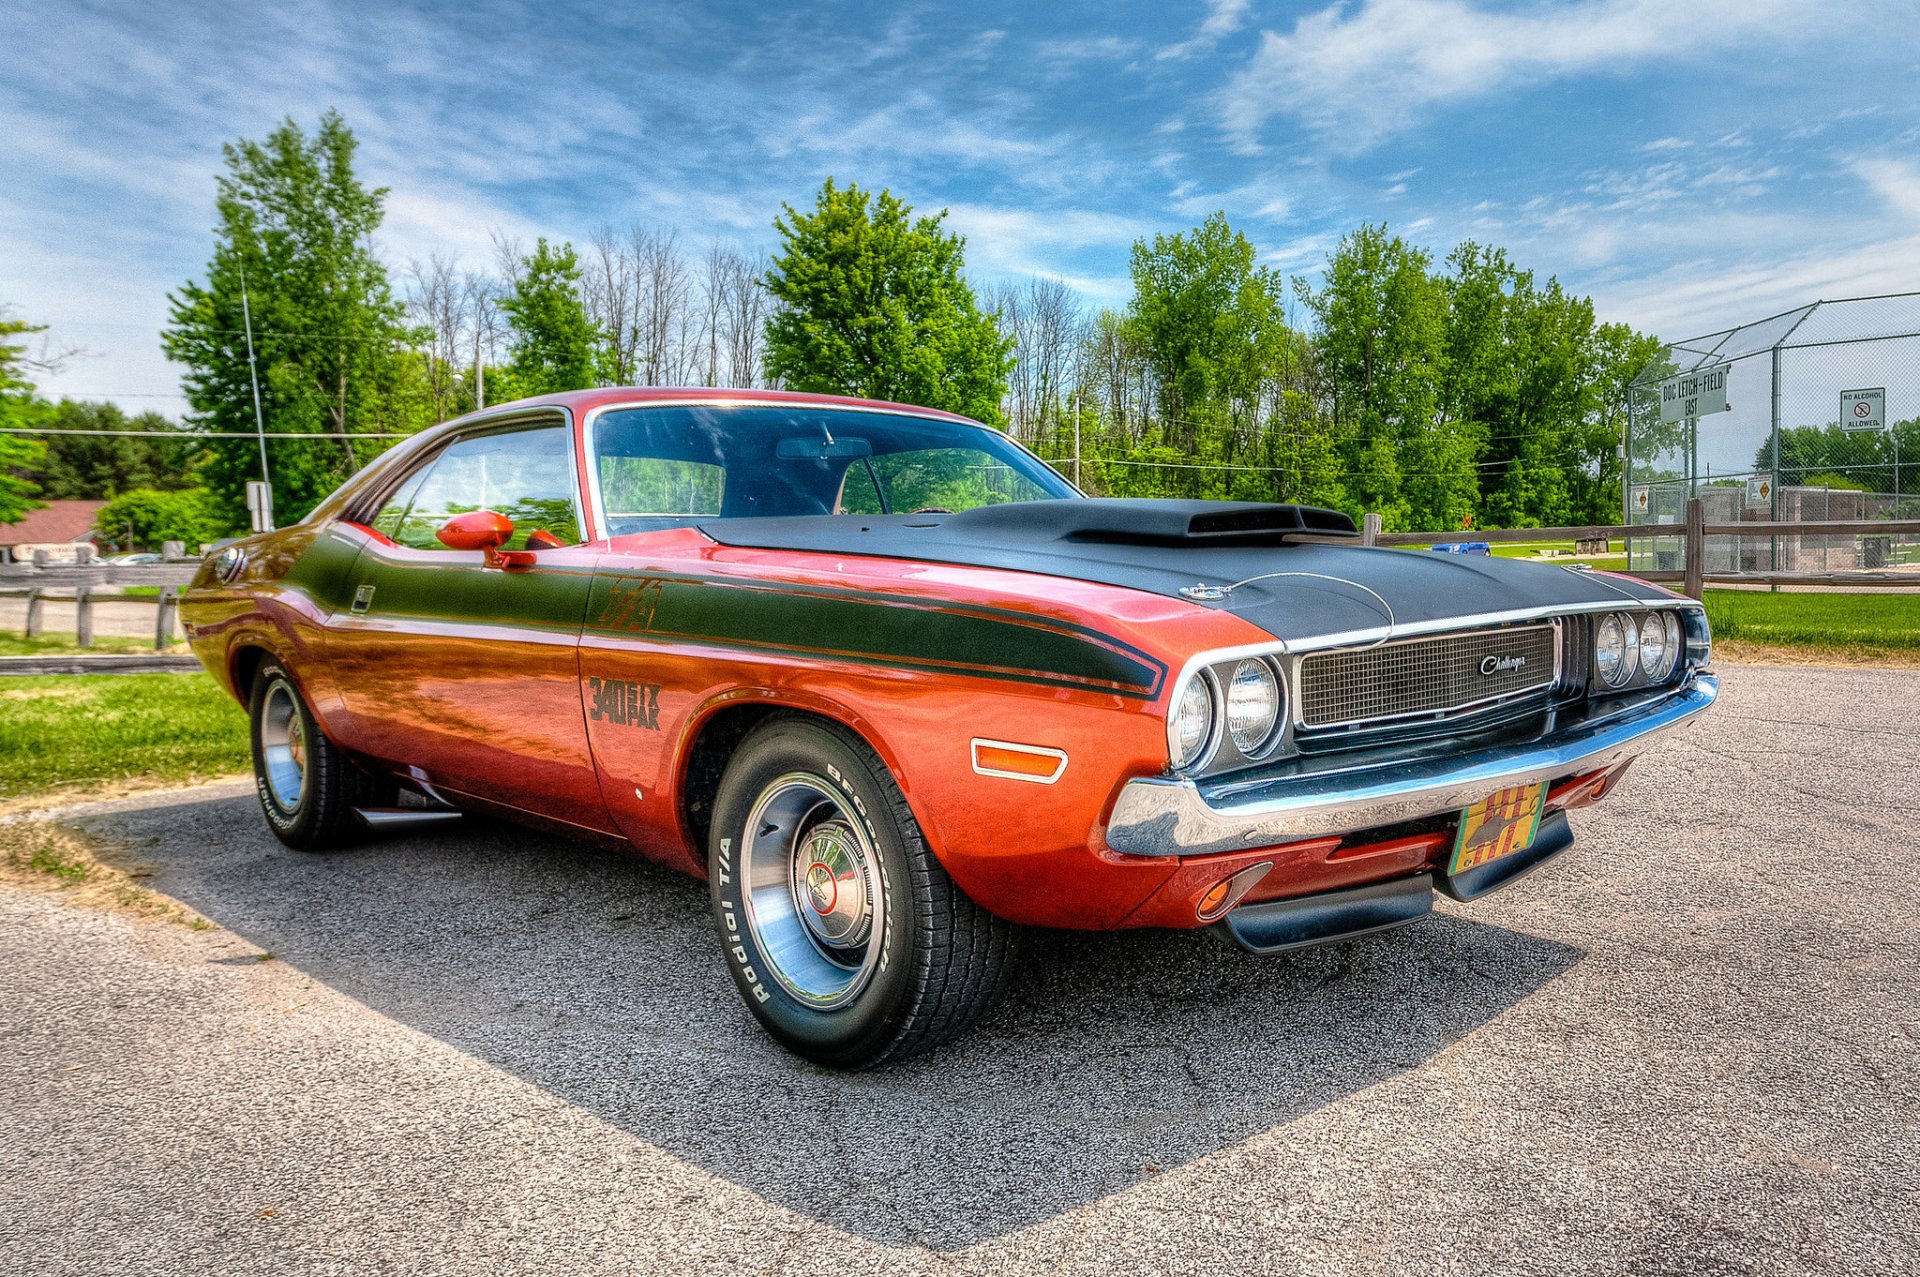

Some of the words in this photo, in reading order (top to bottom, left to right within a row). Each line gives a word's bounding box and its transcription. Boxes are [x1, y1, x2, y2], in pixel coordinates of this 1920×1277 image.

[1663, 384, 1676, 402] DOC
[1854, 392, 1882, 400] ALCOHOL
[1685, 398, 1698, 416] EAST
[1480, 655, 1526, 675] Challenger
[589, 675, 626, 726] 340
[627, 704, 660, 731] PAK
[719, 837, 732, 887] T/A
